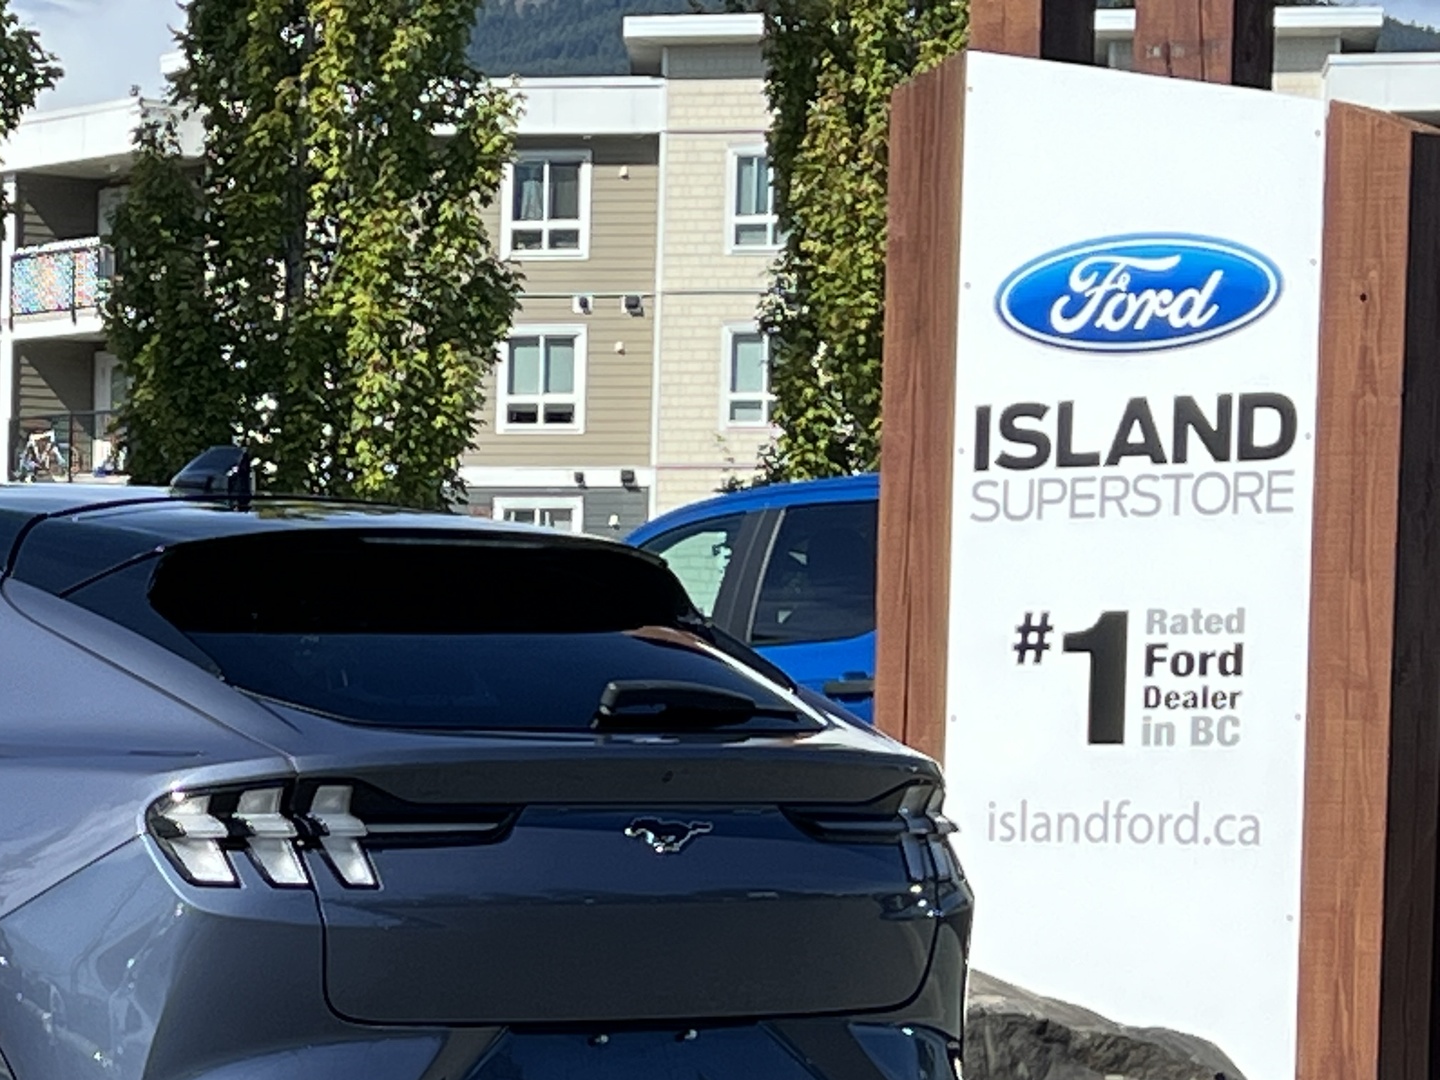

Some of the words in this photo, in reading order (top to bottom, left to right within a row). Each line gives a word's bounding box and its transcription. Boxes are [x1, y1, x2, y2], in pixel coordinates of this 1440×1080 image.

[1050, 254, 1224, 333] Ford
[973, 391, 1298, 473] ISLAND
[970, 469, 1295, 522] SUPERSTORE
[1146, 608, 1245, 635] Rated
[1144, 642, 1244, 678] Ford
[1143, 684, 1243, 711] Dealer
[1142, 715, 1175, 747] in
[1190, 715, 1240, 747] BC
[988, 799, 1260, 846] islandford.ca
